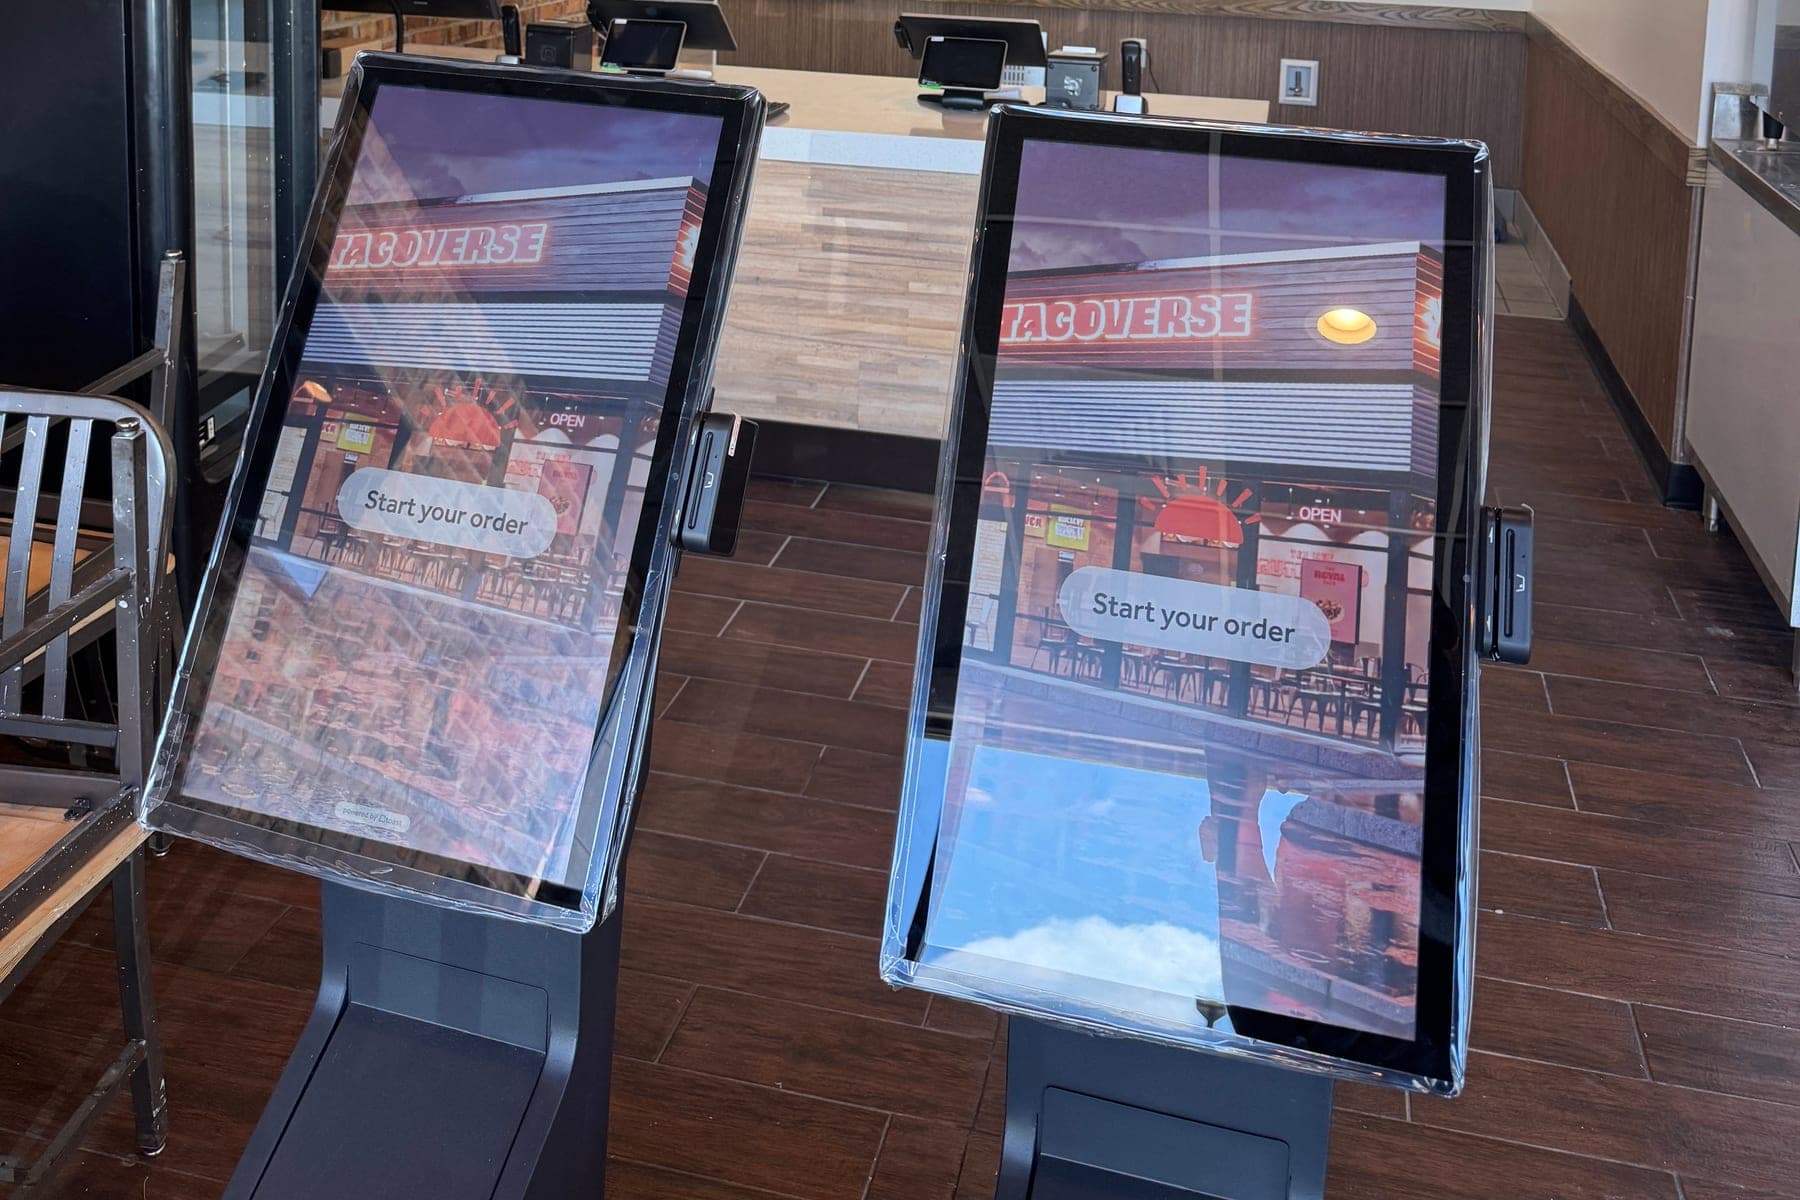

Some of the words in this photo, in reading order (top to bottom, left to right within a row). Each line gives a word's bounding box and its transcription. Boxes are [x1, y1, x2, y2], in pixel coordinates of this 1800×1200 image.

[550, 413, 586, 428] OPEN
[365, 490, 416, 517] Start
[418, 504, 467, 524] your
[470, 512, 528, 535] order
[1299, 506, 1342, 522] OPEN
[1093, 592, 1155, 622] Start
[1160, 608, 1219, 631] your
[1224, 618, 1296, 643] order
